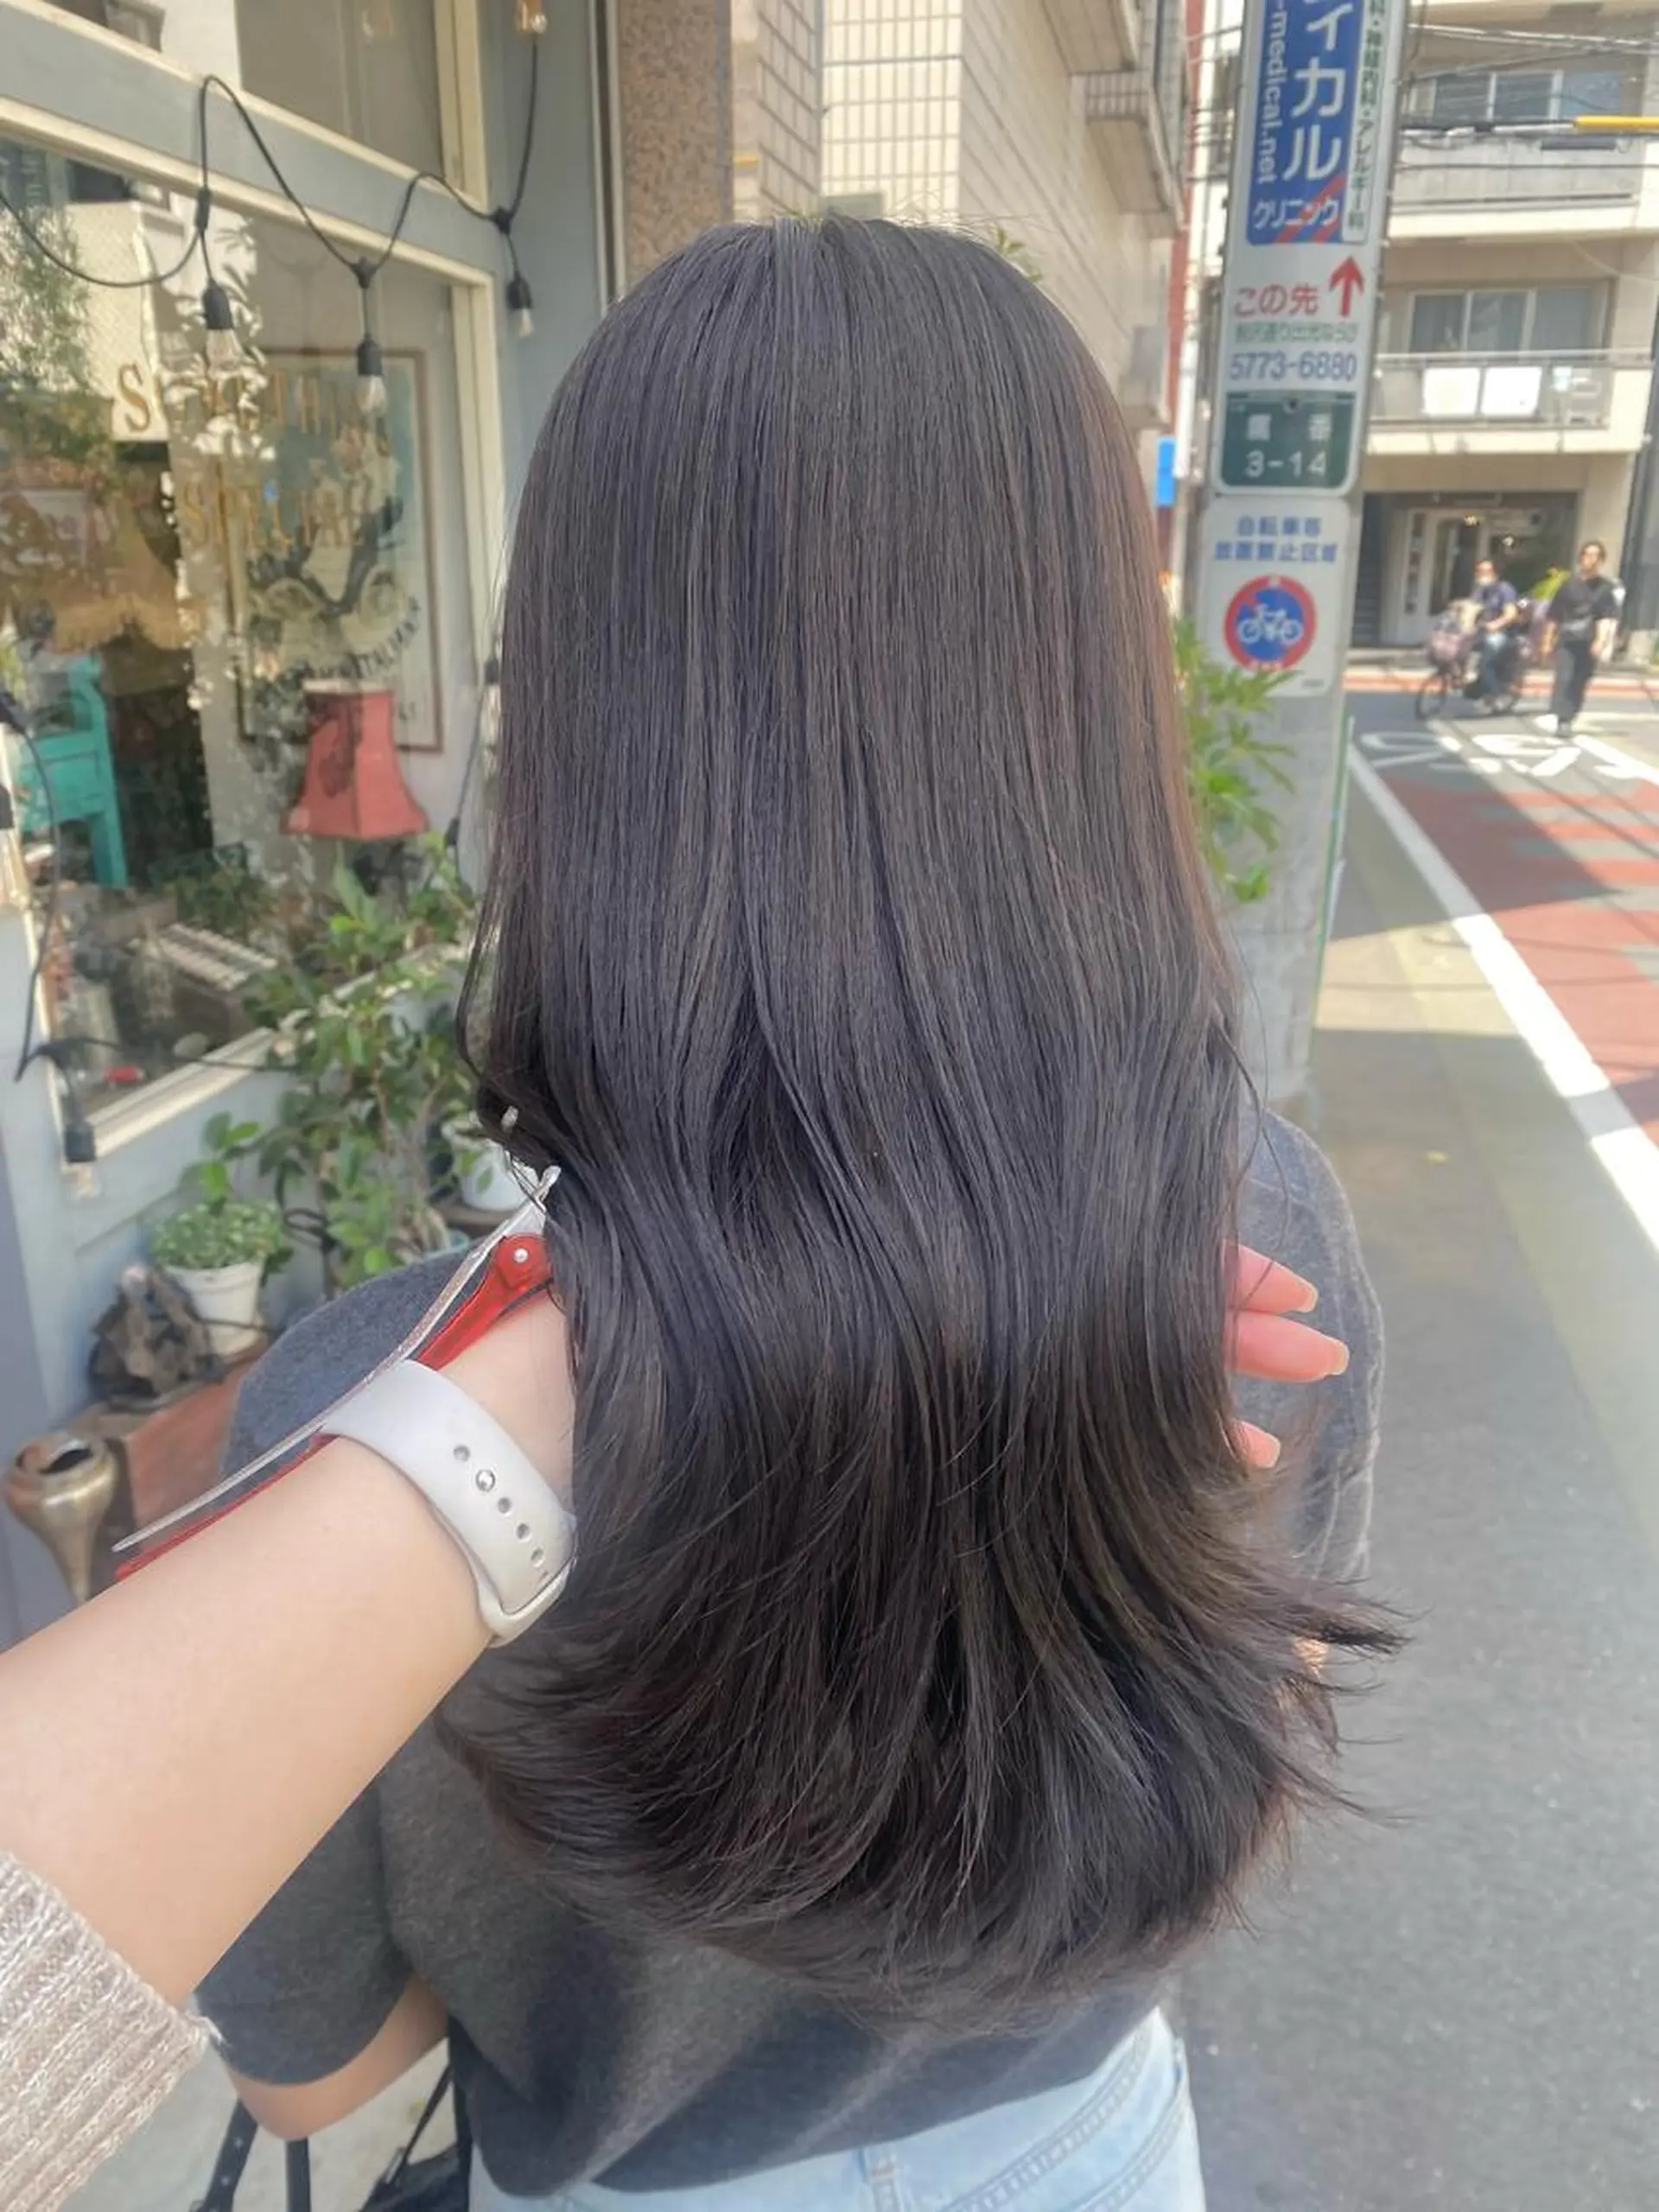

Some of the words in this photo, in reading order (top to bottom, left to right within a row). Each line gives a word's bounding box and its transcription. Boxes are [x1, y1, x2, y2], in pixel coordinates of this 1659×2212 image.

[1253, 197, 1340, 230] クリニック
[1234, 283, 1319, 317] この先
[1229, 350, 1358, 382] 5773-6880
[1244, 449, 1327, 479] 3-14
